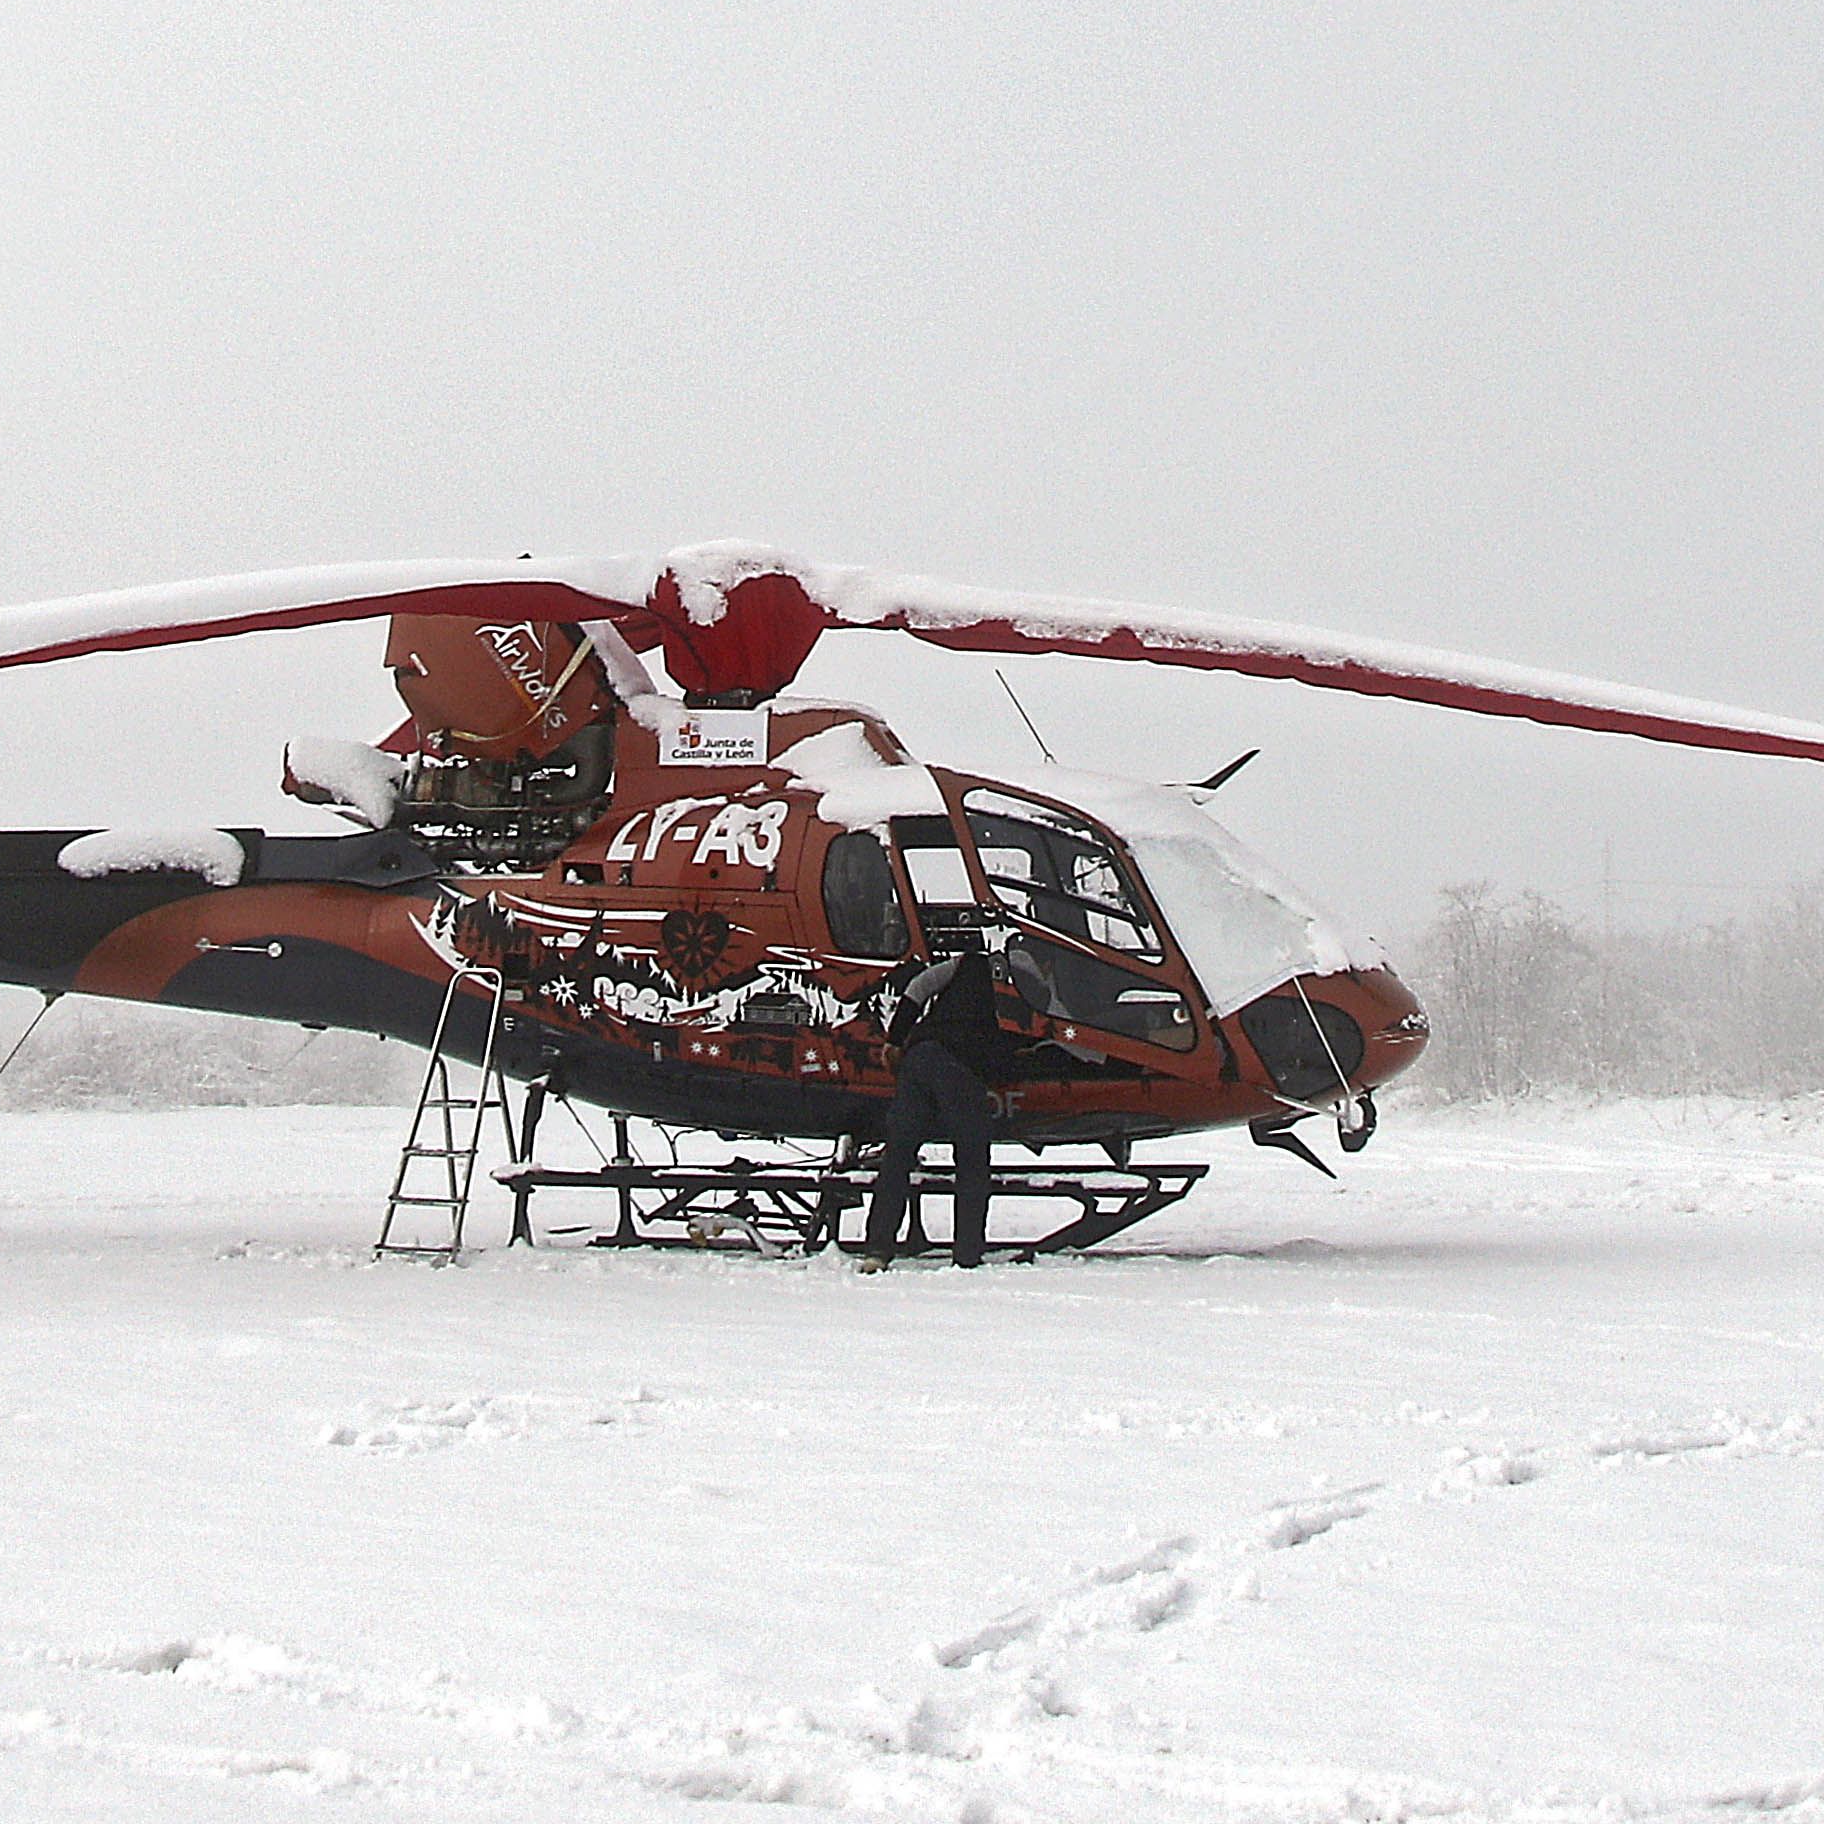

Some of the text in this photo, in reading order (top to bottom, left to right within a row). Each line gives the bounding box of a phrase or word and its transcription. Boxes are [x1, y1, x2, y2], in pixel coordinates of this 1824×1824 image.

[704, 738, 754, 748] Junta de
[671, 749, 754, 759] Castilla y León
